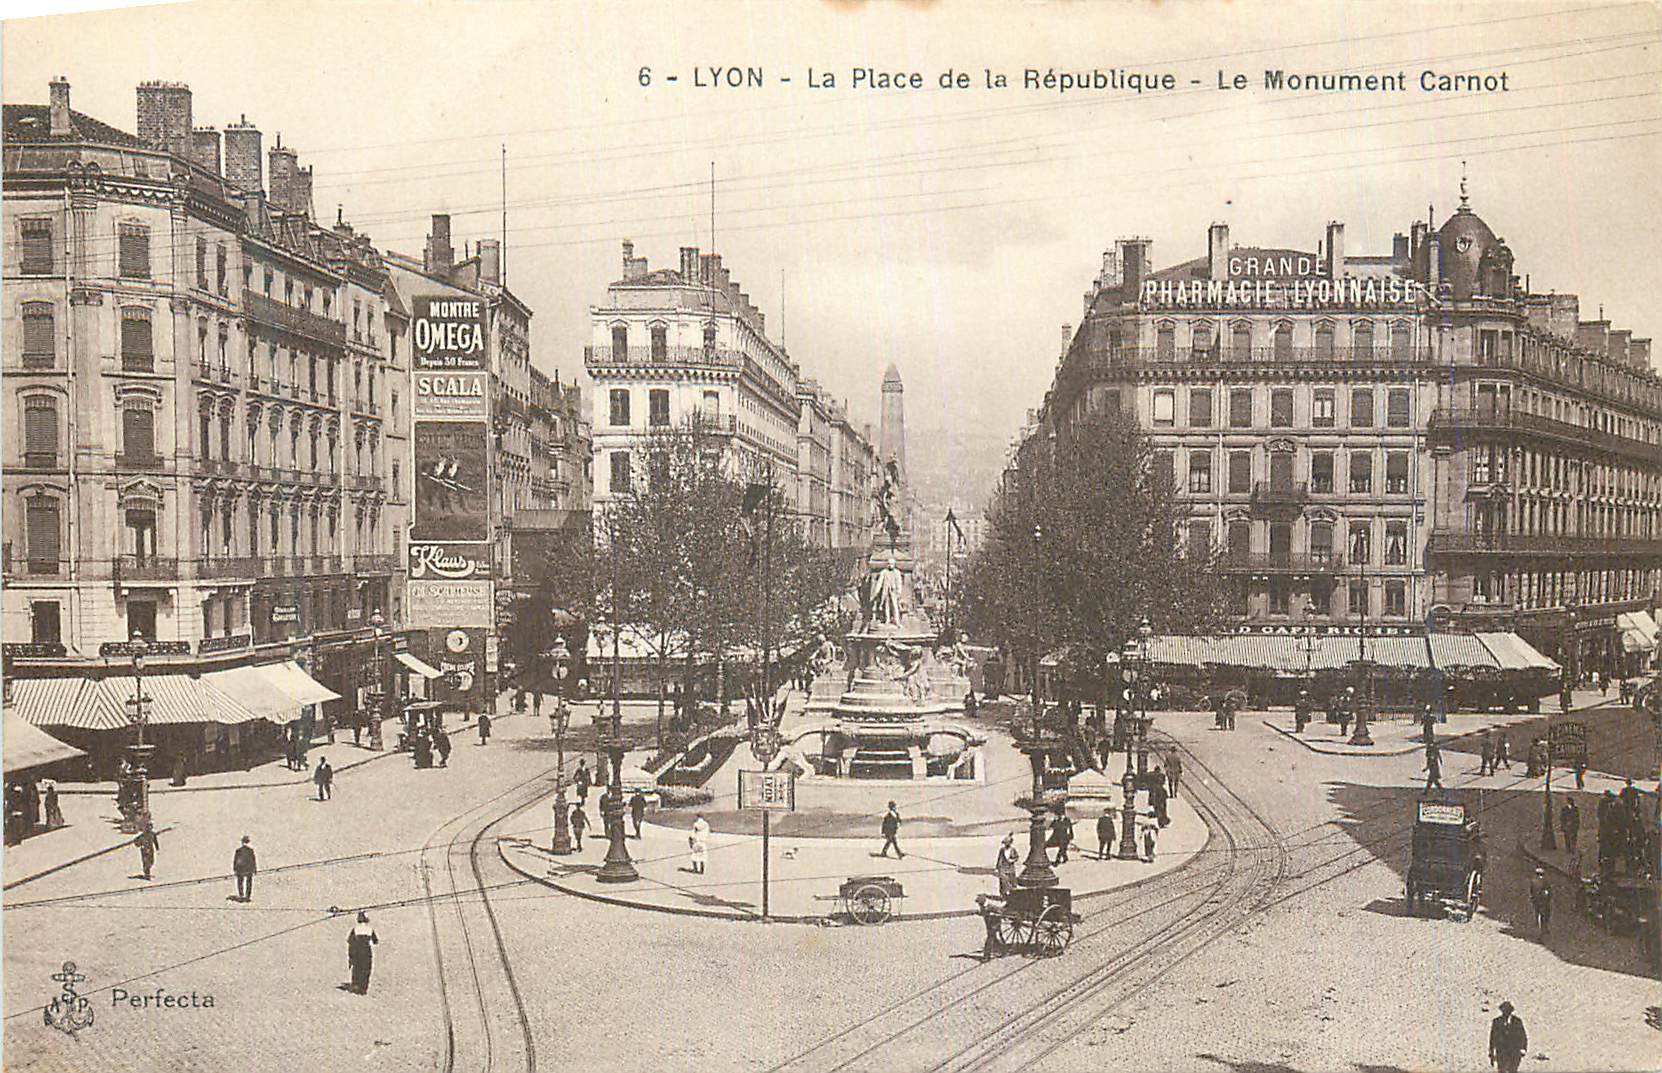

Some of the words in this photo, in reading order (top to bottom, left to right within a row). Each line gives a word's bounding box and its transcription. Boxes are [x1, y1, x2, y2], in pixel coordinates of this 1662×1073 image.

[1229, 257, 1327, 276] GRANDE
[1145, 279, 1276, 303] PHARMACIE
[1295, 279, 1416, 303] LYONNAISE
[430, 302, 479, 318] MONTRE
[415, 318, 484, 354] OMEGA
[418, 376, 483, 396] SCALA
[411, 545, 476, 578] Klaus
